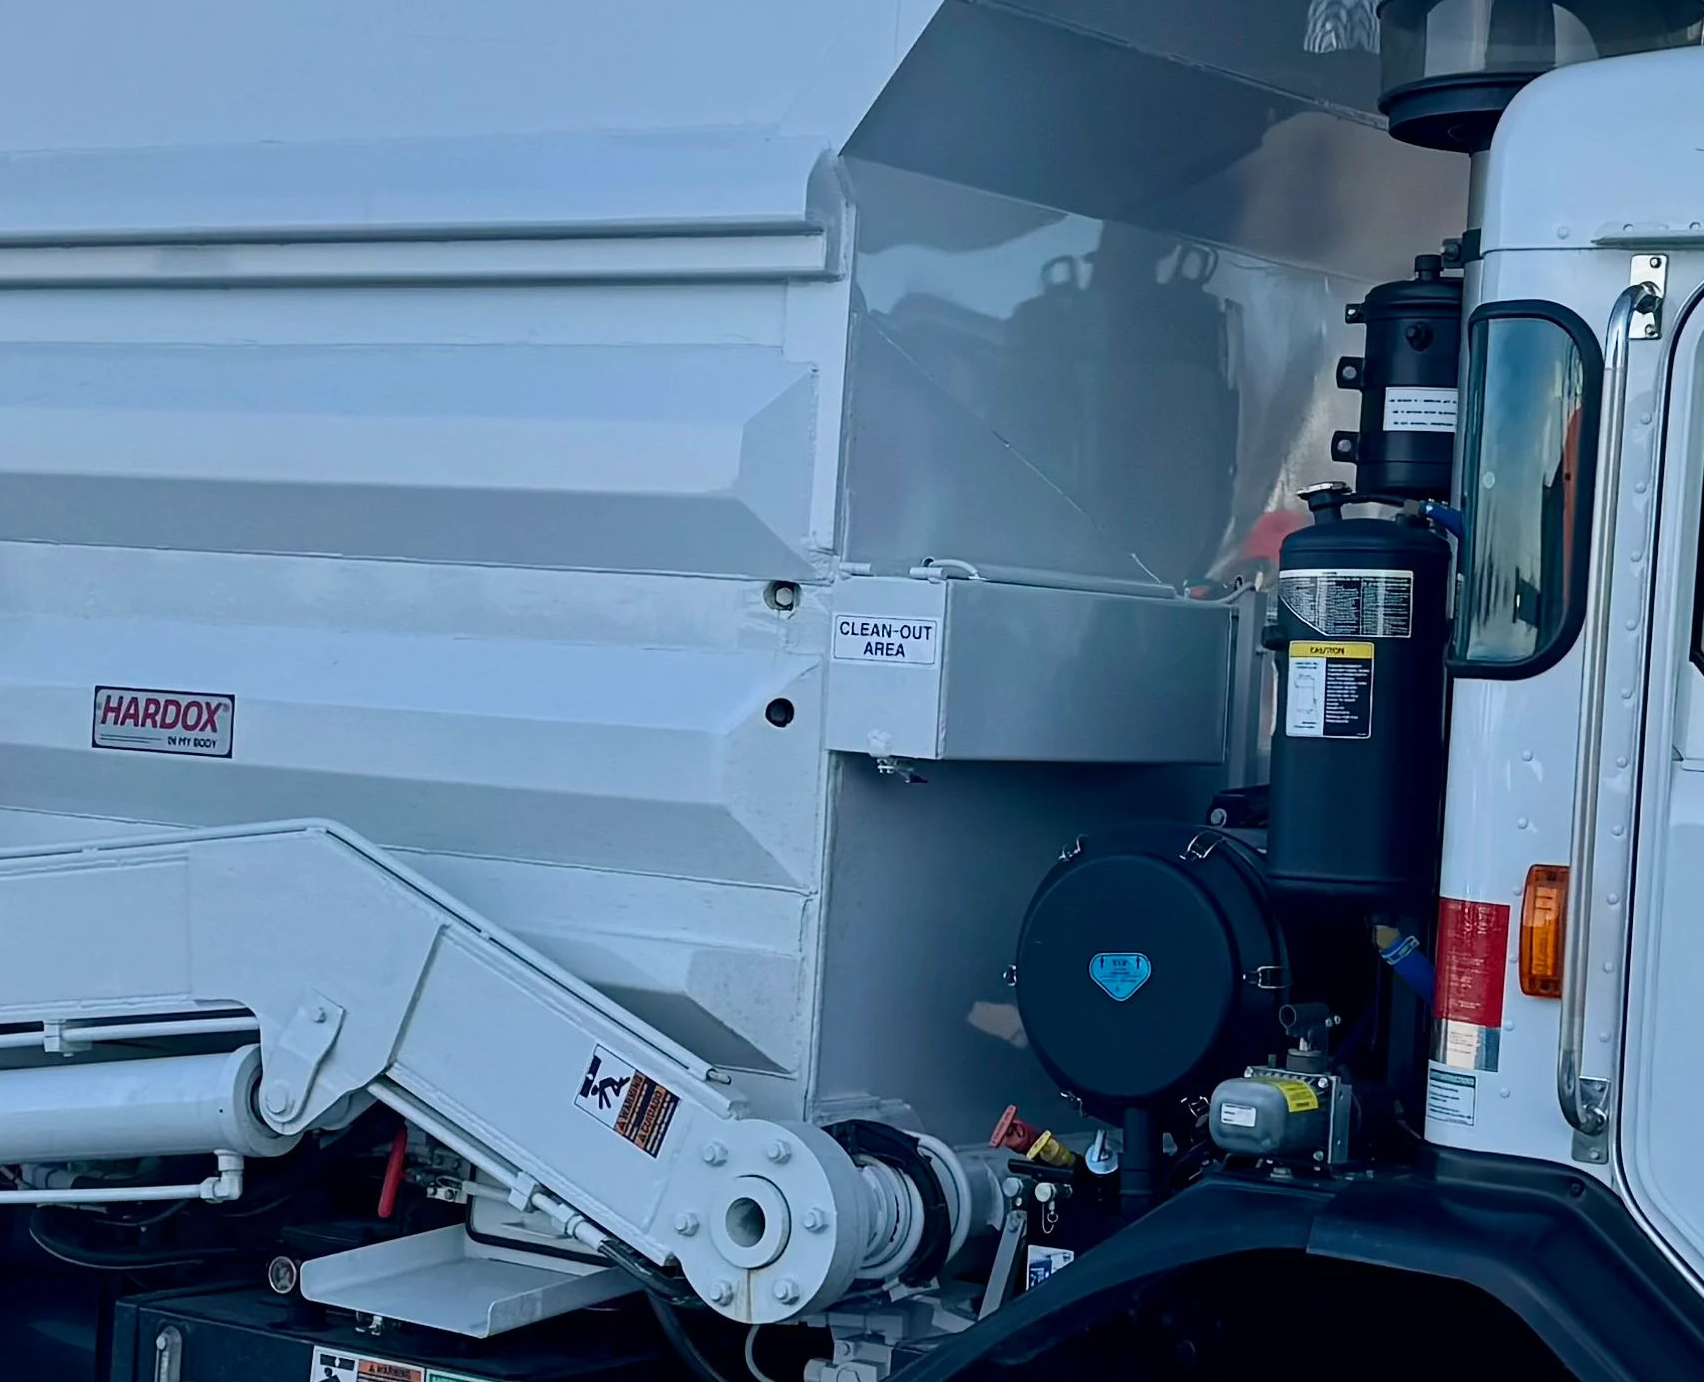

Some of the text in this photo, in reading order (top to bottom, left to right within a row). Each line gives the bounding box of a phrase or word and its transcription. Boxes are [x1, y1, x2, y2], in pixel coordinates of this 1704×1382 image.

[839, 621, 933, 641] CLEAN-OUT
[863, 641, 906, 658] AREA
[1310, 646, 1345, 655] CAUTION
[100, 694, 222, 734] HARDOX
[178, 737, 191, 747] MY
